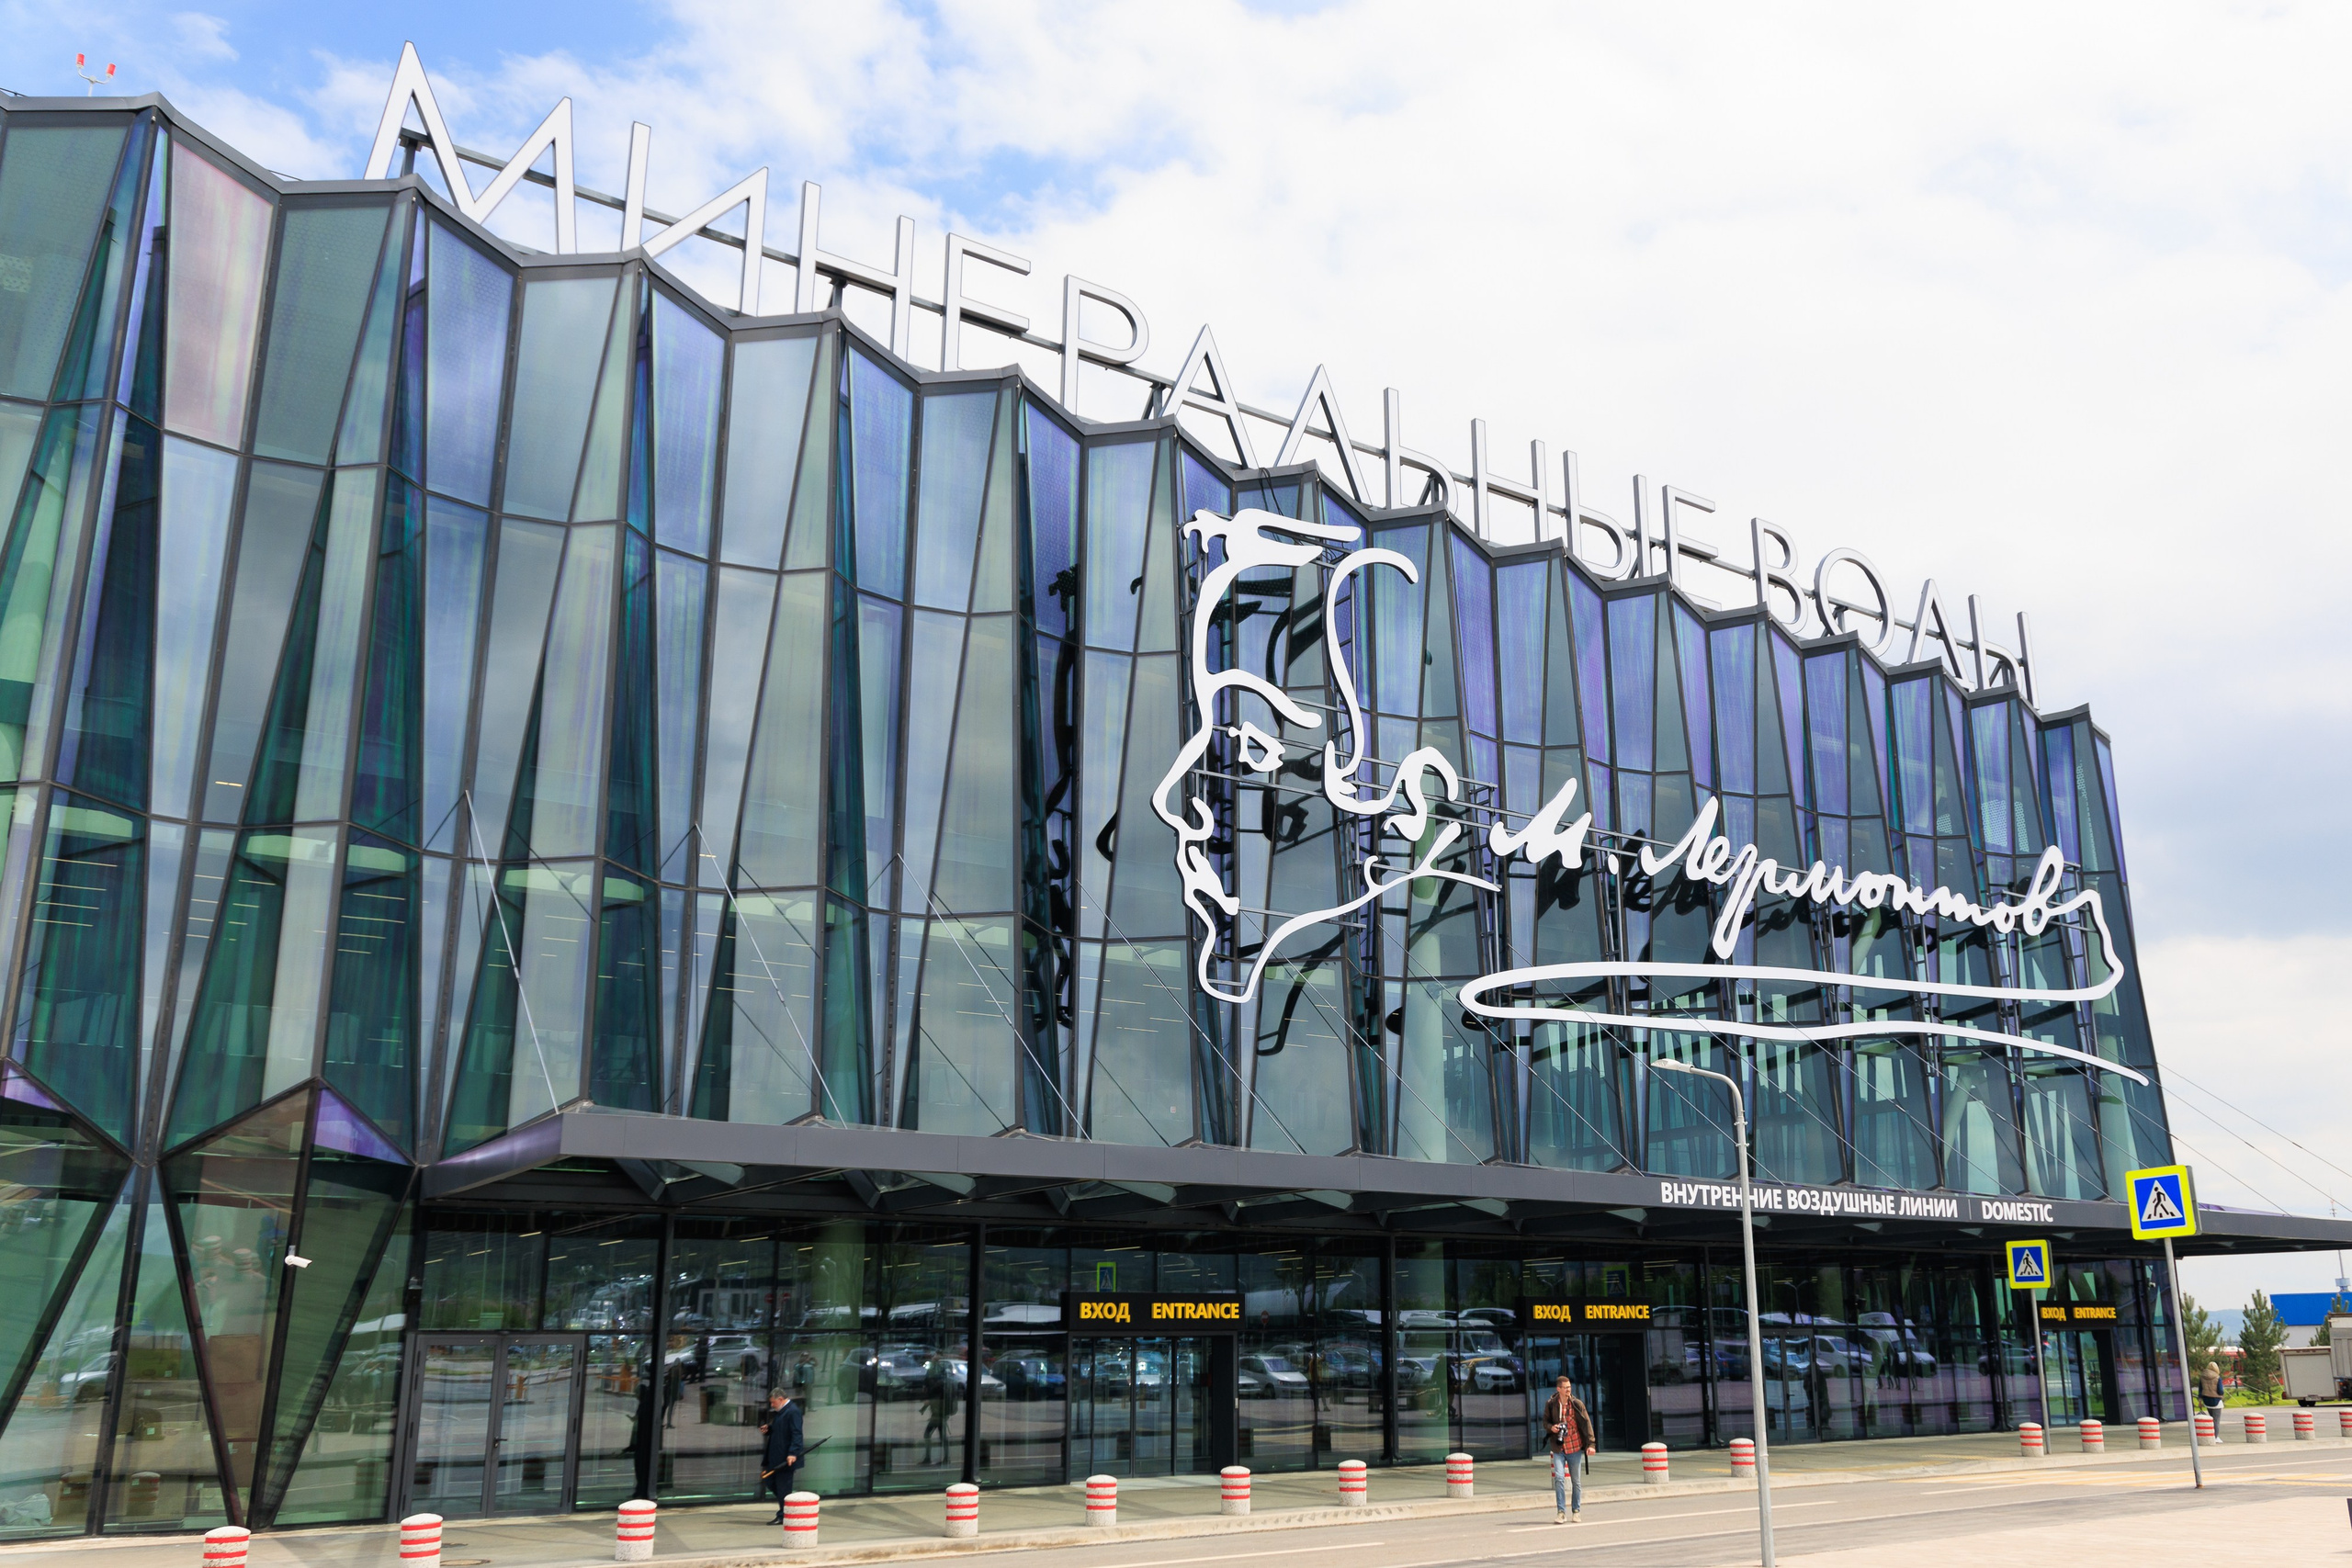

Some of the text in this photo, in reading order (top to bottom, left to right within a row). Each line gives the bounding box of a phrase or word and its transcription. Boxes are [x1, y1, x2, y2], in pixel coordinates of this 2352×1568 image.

[364, 39, 2041, 711] МИНЕРАЛЬНЫЕ ВОДЫ
[1660, 1181, 2054, 1223] ВНУТРЕННИЕ ВОЗДУШНЫЕ ЛИНИИ DOMESTIC
[1080, 1303, 1240, 1323] ВХОД ENTRANCE
[1532, 1304, 1651, 1323] ВХОД ENTRANCE
[2041, 1307, 2117, 1322] ВХОД ENTRANCE
